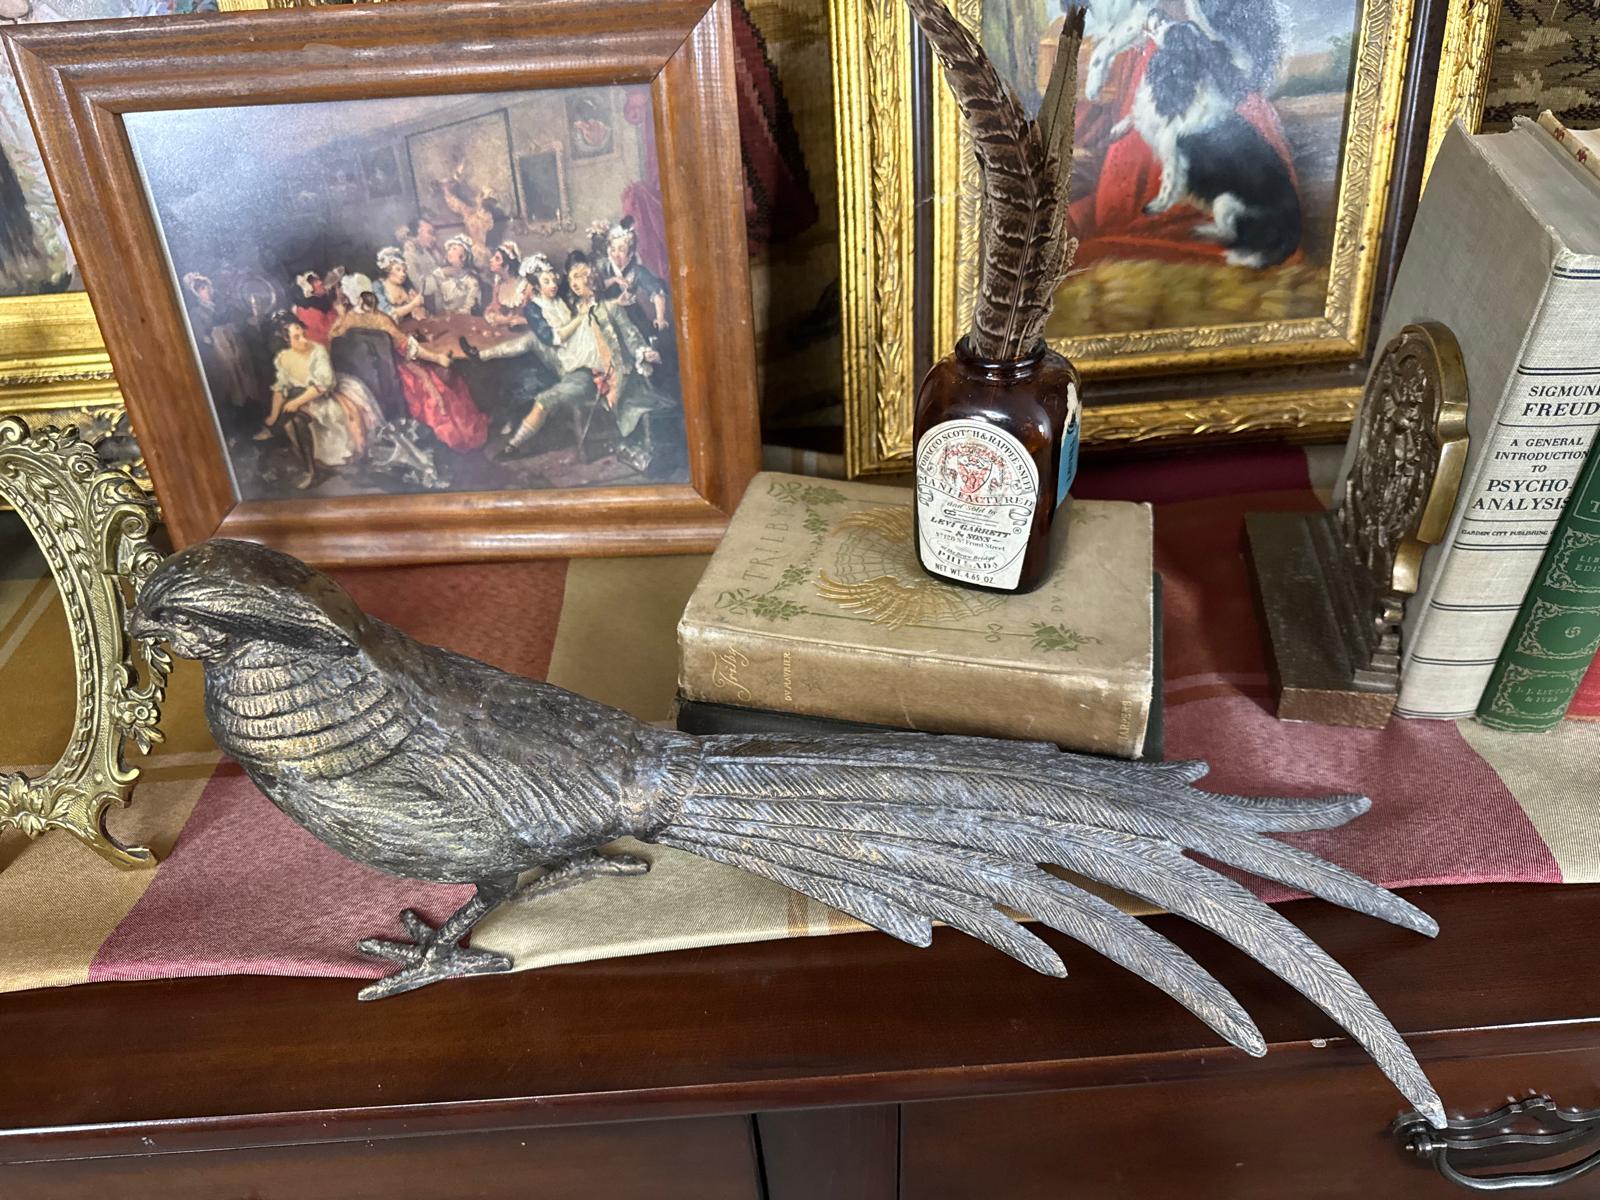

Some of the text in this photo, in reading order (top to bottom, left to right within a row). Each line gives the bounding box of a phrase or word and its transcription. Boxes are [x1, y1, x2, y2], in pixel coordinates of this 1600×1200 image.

[1521, 402, 1600, 417] FREUD
[1510, 438, 1584, 447] A GENERAL
[920, 438, 943, 473] TOBACCO
[989, 435, 1020, 466] RAPPEE
[1017, 464, 1032, 491] SNUFF
[1494, 451, 1589, 461] INTRODUCTION
[1531, 465, 1547, 473] TO
[1486, 478, 1573, 493] PSYCHO-
[930, 516, 956, 528] LEVI
[960, 524, 1011, 538] GARRETT
[742, 507, 796, 581] TRILBY
[966, 533, 991, 543] SONS
[935, 563, 947, 572] NET
[965, 571, 980, 581] 4.65
